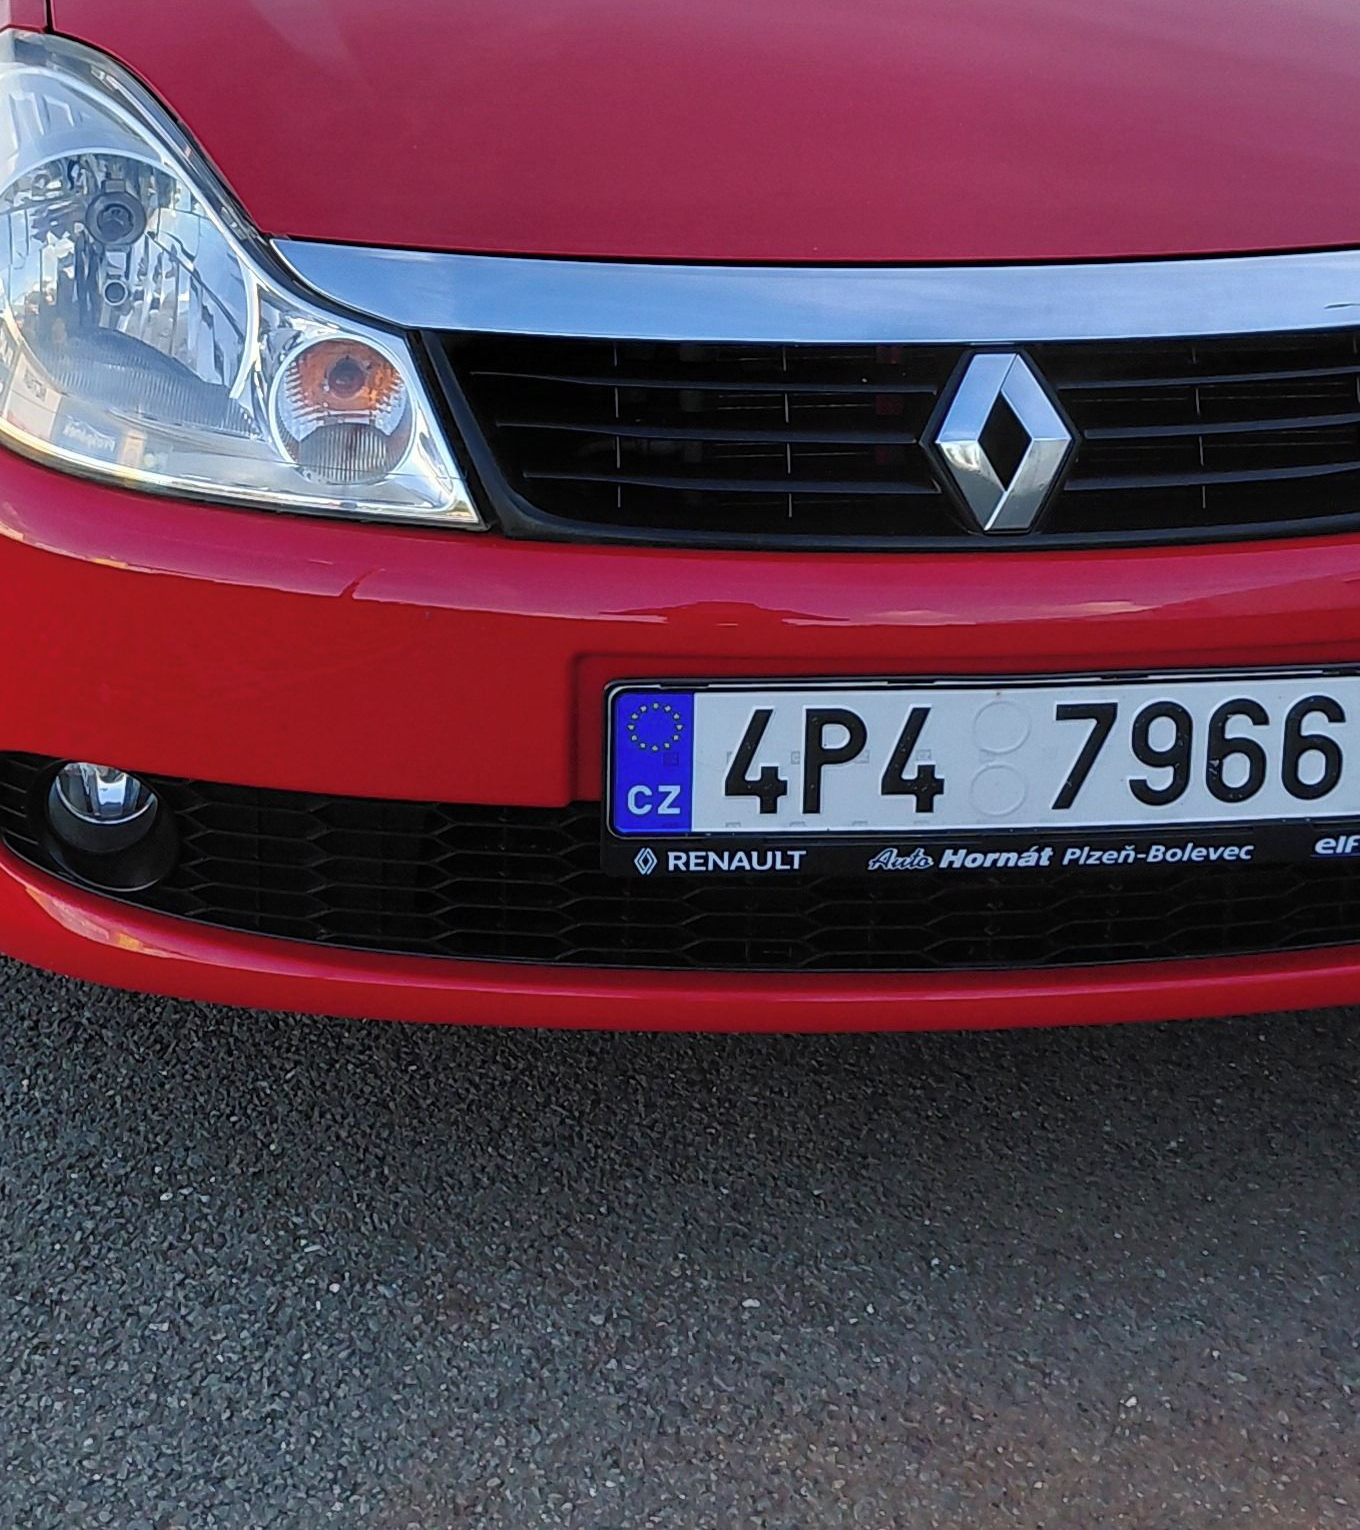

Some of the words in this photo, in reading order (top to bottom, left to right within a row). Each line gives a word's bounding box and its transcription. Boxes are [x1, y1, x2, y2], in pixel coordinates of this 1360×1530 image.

[724, 706, 945, 815] 4P4
[1051, 694, 1347, 811] 7966
[627, 784, 682, 815] CZ
[667, 849, 807, 872] RENAULT
[867, 847, 934, 871] Auto
[938, 845, 1053, 869] Hornát
[1061, 843, 1255, 866] Plzeň-Bolevec
